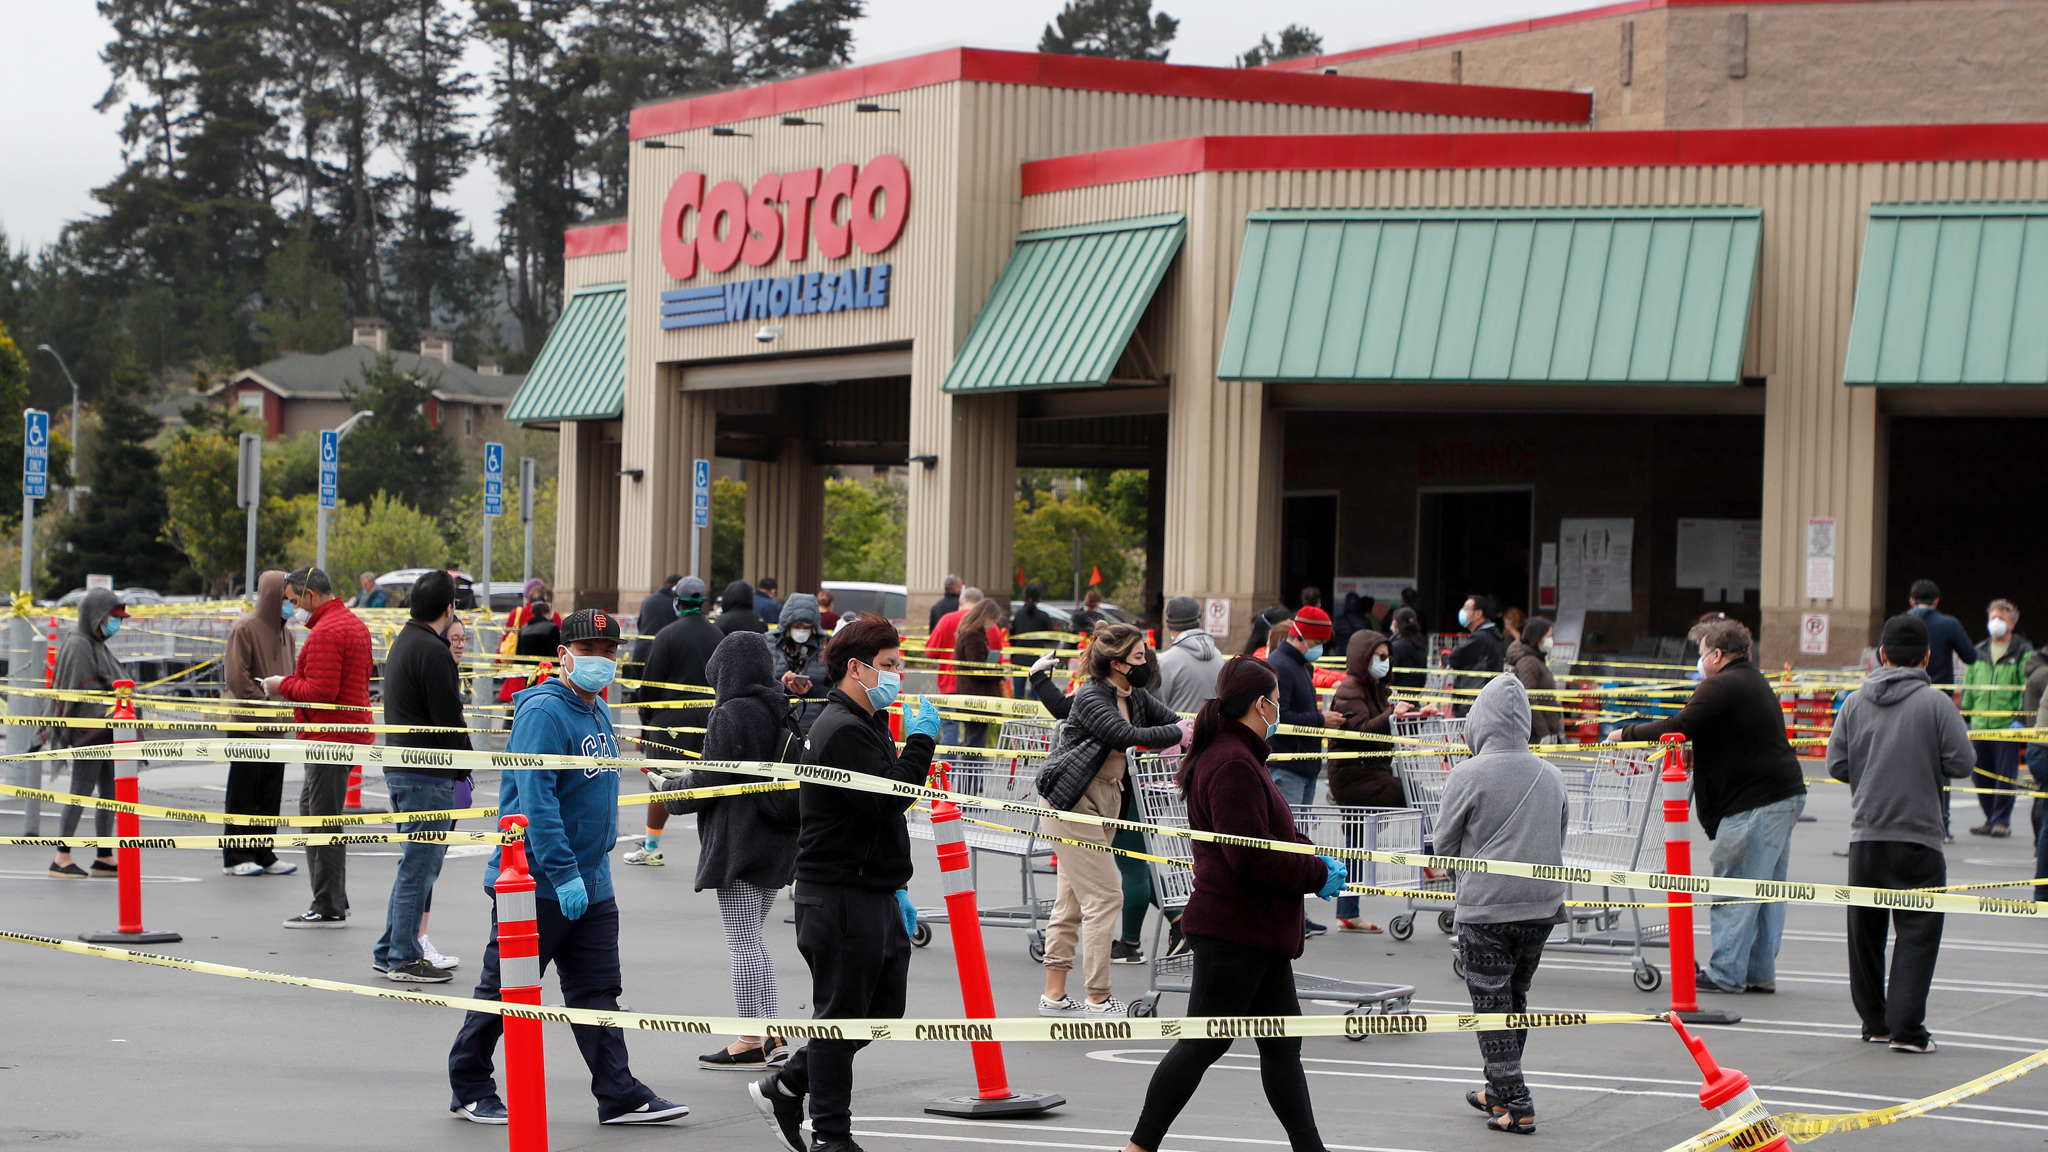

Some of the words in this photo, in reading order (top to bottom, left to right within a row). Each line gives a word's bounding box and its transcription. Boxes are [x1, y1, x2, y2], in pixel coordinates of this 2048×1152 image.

[660, 154, 911, 280] COSTCO
[724, 264, 892, 322] WHOLESALE
[915, 1023, 993, 1041] CAUTION
[1050, 1021, 1131, 1040] CUIDADO
[1206, 1017, 1285, 1038] CAUTION
[1345, 1015, 1427, 1035] CUIDADO
[1505, 1013, 1587, 1029] CAUTION
